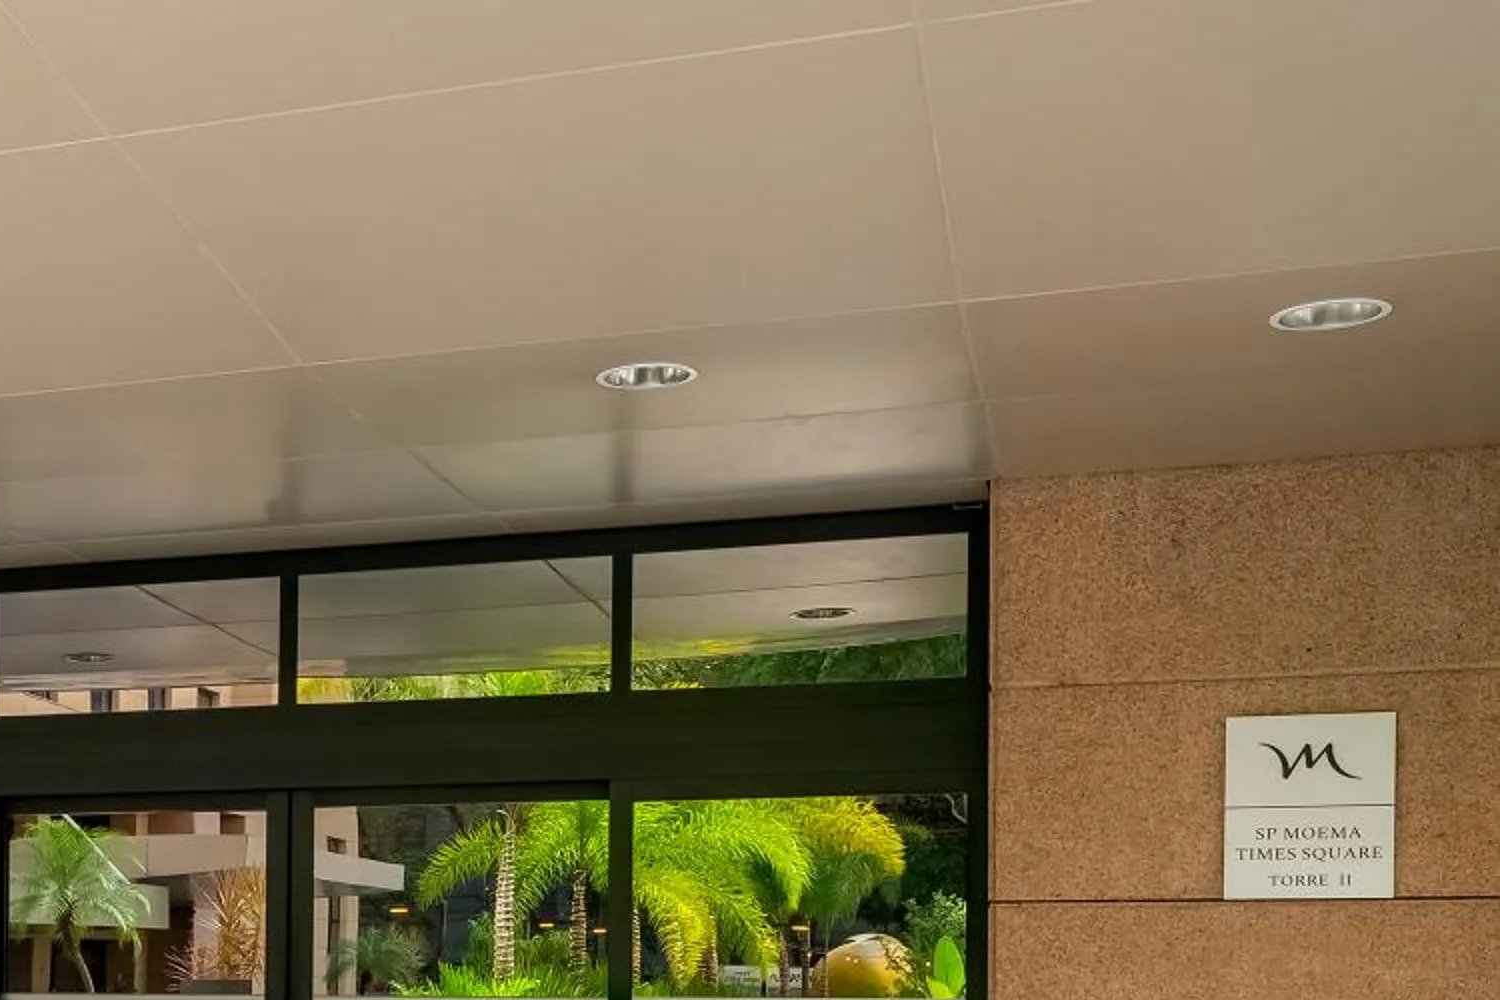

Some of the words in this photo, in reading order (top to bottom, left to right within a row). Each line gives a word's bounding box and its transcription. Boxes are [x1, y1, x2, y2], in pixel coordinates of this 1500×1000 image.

[1254, 827, 1277, 841] SP
[1283, 826, 1362, 840] MOEMA
[1235, 847, 1298, 861] TIMES
[1300, 846, 1383, 862] SQUARE
[1268, 875, 1330, 887] TORRE
